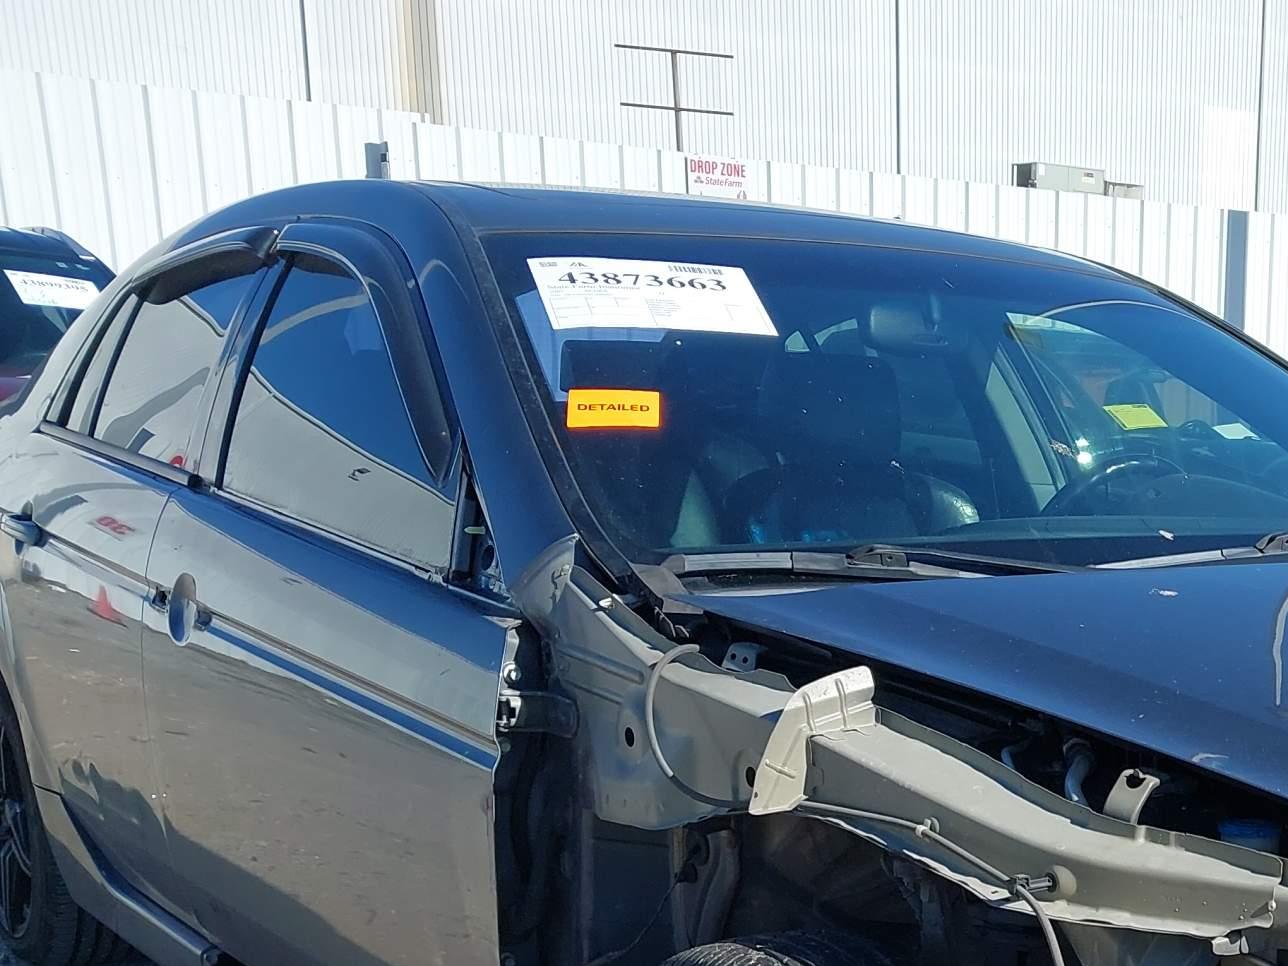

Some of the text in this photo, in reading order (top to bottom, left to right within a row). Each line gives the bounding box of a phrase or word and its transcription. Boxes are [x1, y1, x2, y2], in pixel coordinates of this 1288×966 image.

[690, 159, 746, 178] DROP ZONE
[558, 271, 727, 291] 43873663
[577, 403, 650, 412] DETAILED
